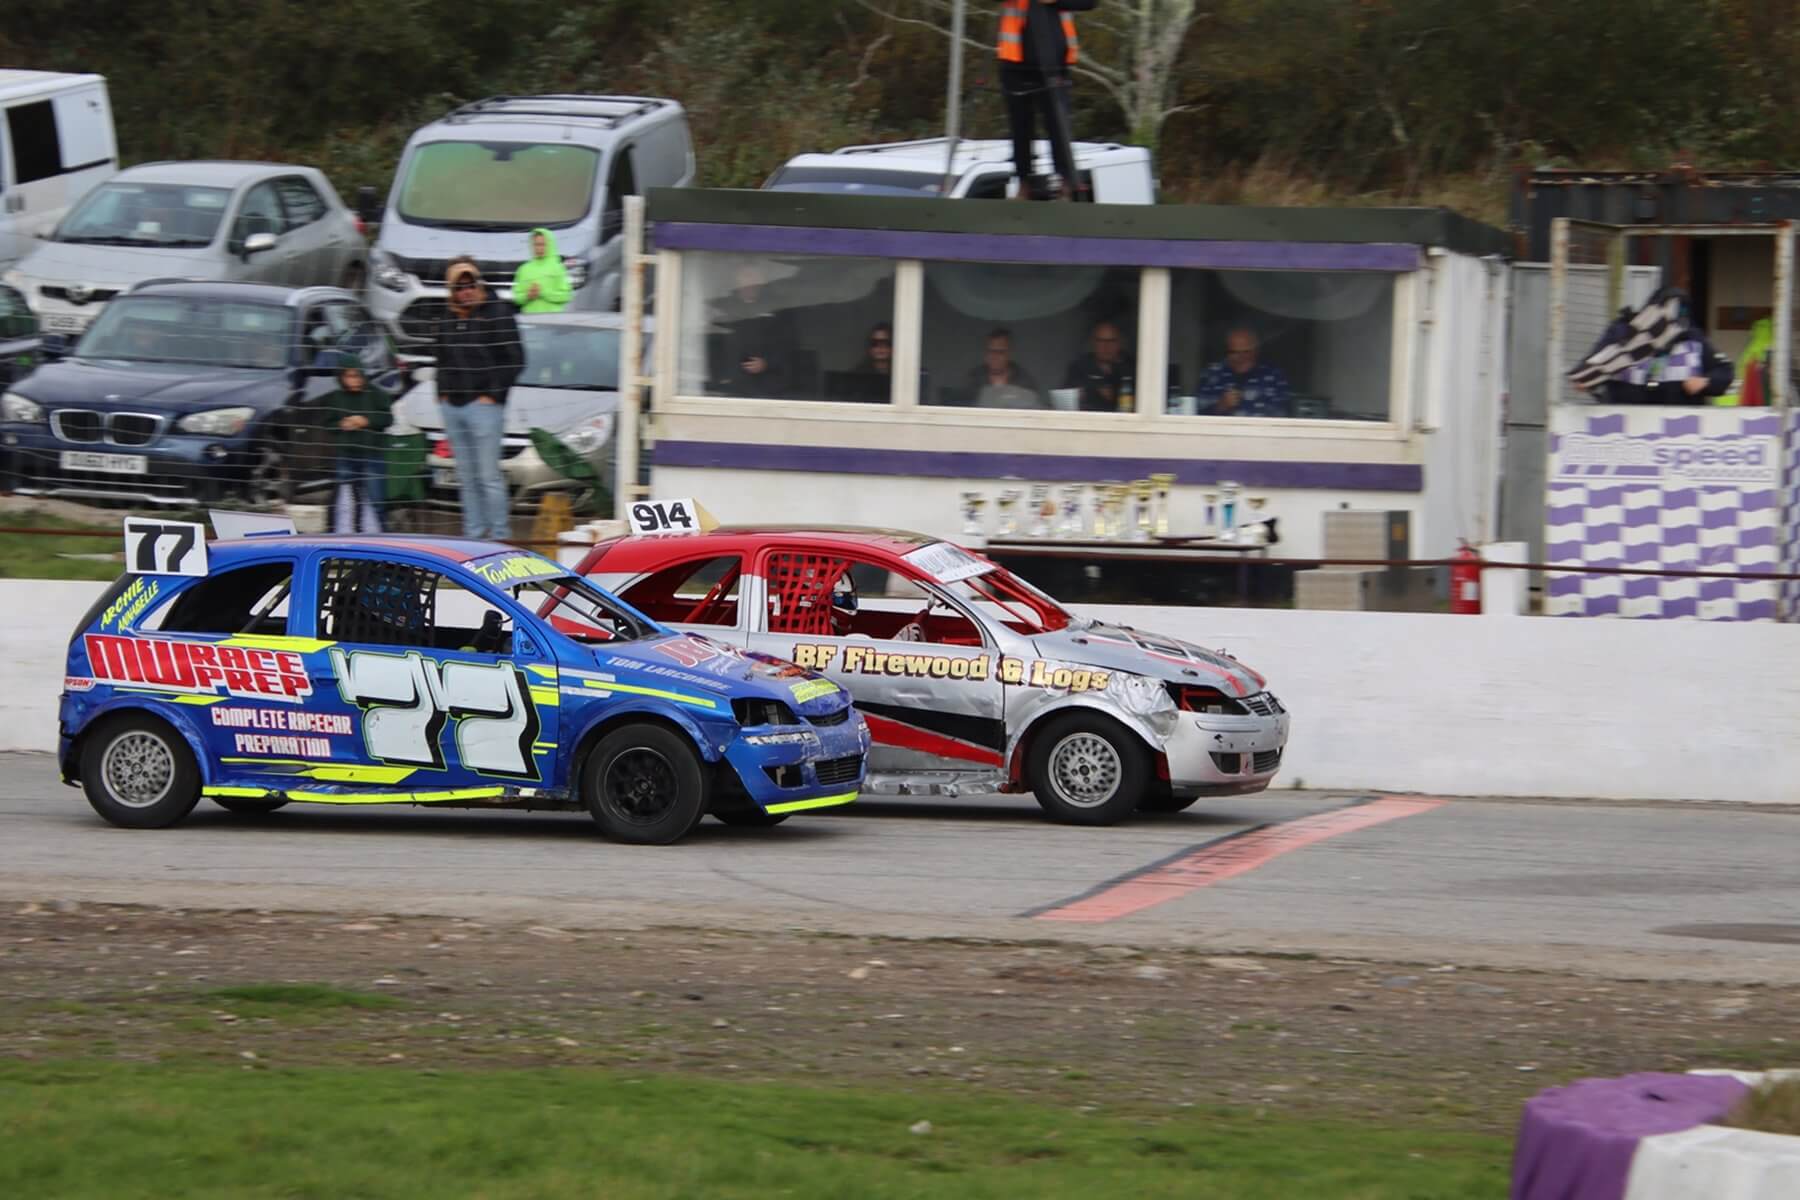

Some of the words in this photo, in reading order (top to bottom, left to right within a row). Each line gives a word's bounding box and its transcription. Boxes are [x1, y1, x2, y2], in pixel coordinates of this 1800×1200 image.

[632, 502, 692, 531] 914
[128, 524, 196, 572] 77
[189, 644, 303, 675] RACE
[606, 656, 646, 670] TOM
[643, 664, 733, 690] LARCOMBE
[793, 643, 838, 671] BF
[843, 646, 991, 682] Firewood
[999, 652, 1025, 684] &
[1030, 660, 1110, 692] Logs
[195, 666, 310, 697] PREP
[210, 706, 288, 729] COMPLETE
[287, 711, 353, 735] RACECAR
[328, 648, 542, 781] 77
[234, 733, 332, 757] PREPARATION
